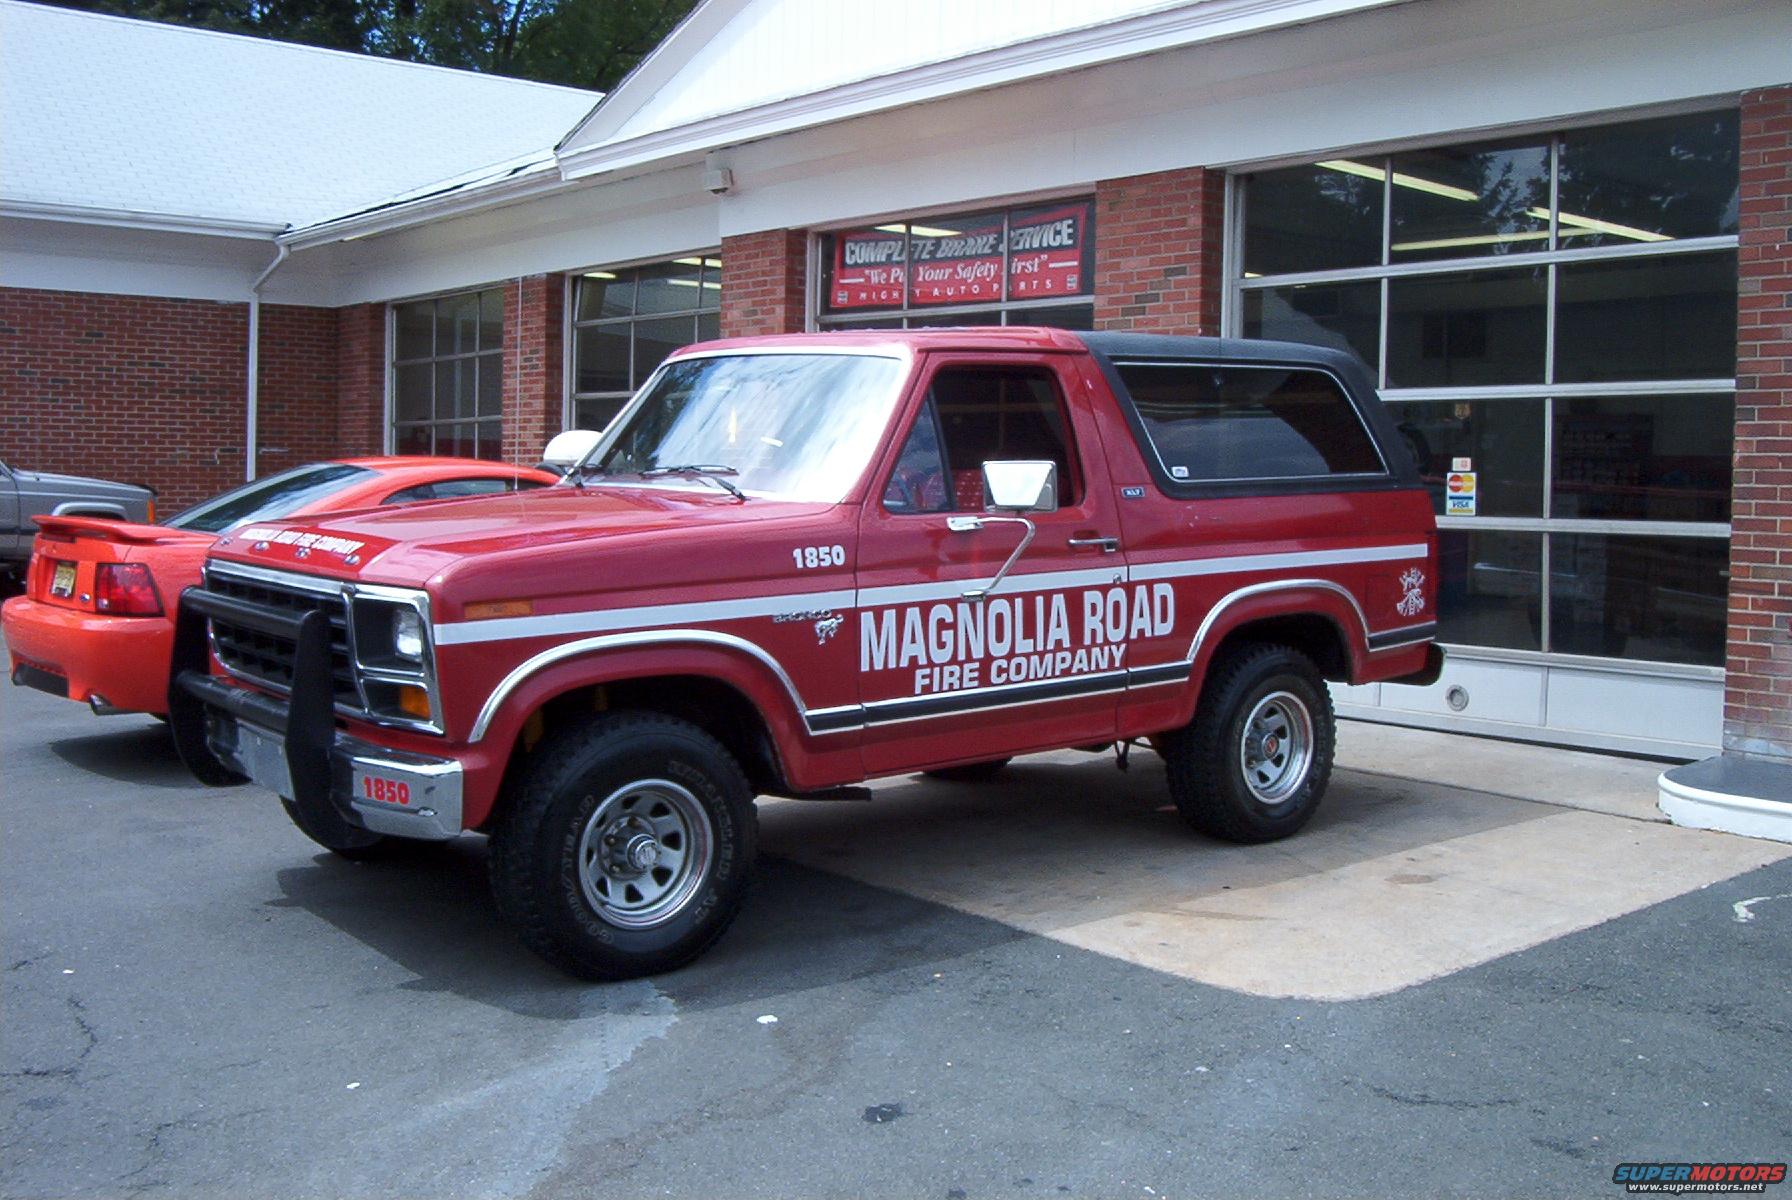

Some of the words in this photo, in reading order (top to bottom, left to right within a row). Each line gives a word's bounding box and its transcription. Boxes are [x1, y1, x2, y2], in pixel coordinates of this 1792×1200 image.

[845, 240, 936, 265] COMPLTE
[936, 233, 998, 259] BRAKE
[917, 264, 953, 282] Your
[955, 260, 998, 283] Safety
[1002, 254, 1048, 275] irst"
[859, 287, 921, 300] MIGHY
[932, 284, 980, 297] AUTO
[992, 279, 1052, 292] PRTS
[793, 545, 845, 568] 1850
[860, 592, 1070, 672] MAGNOLIA
[1083, 582, 1175, 646] ROAD
[914, 665, 979, 694] FIRE
[990, 644, 1126, 685] COMPANY
[363, 776, 410, 805] 1850
